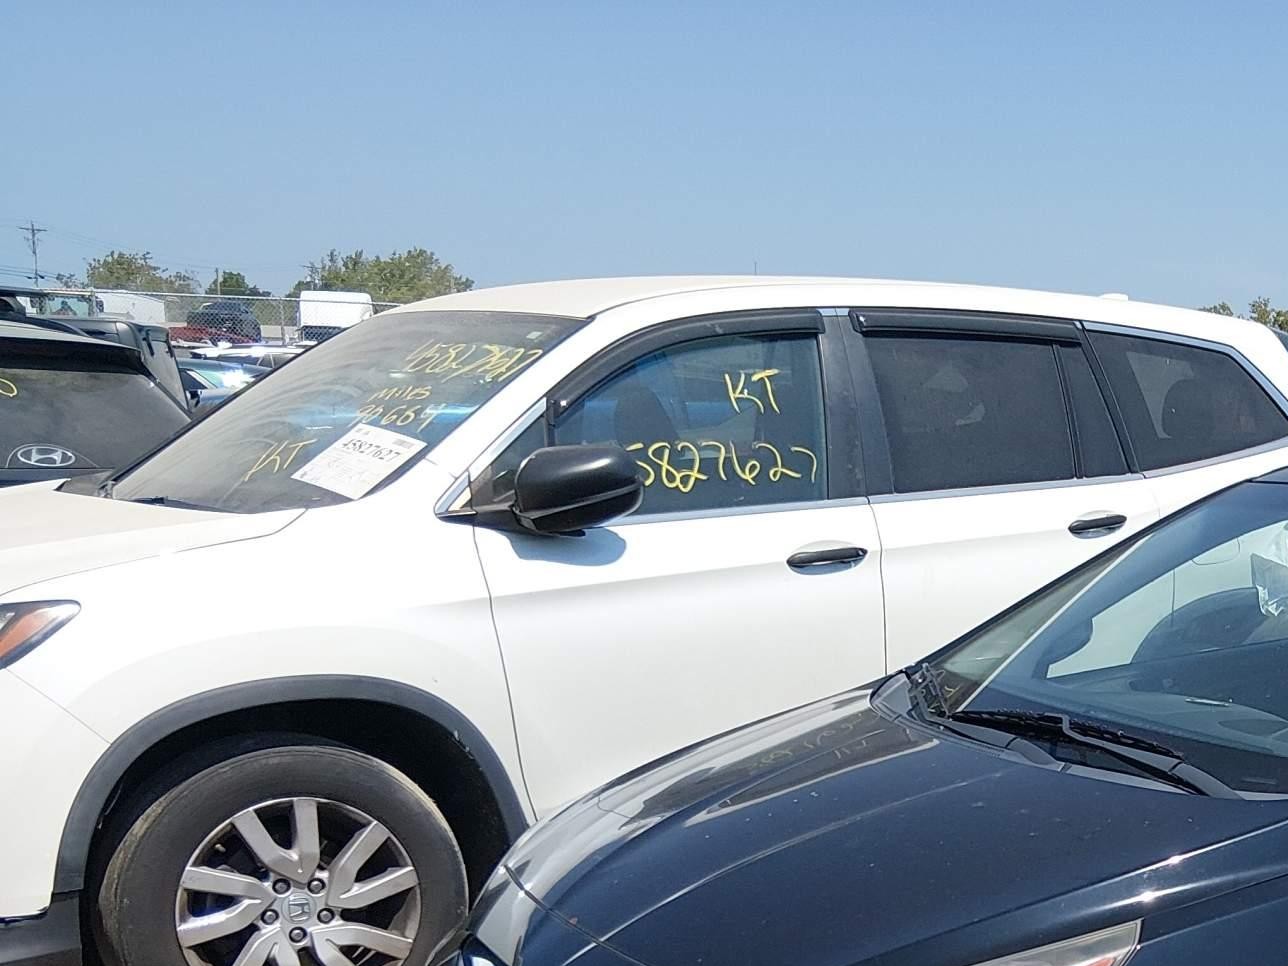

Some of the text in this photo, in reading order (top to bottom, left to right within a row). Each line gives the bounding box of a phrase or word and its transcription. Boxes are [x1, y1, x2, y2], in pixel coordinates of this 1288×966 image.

[724, 367, 781, 415] KT
[241, 438, 318, 482] KT
[341, 438, 401, 463] 45827627
